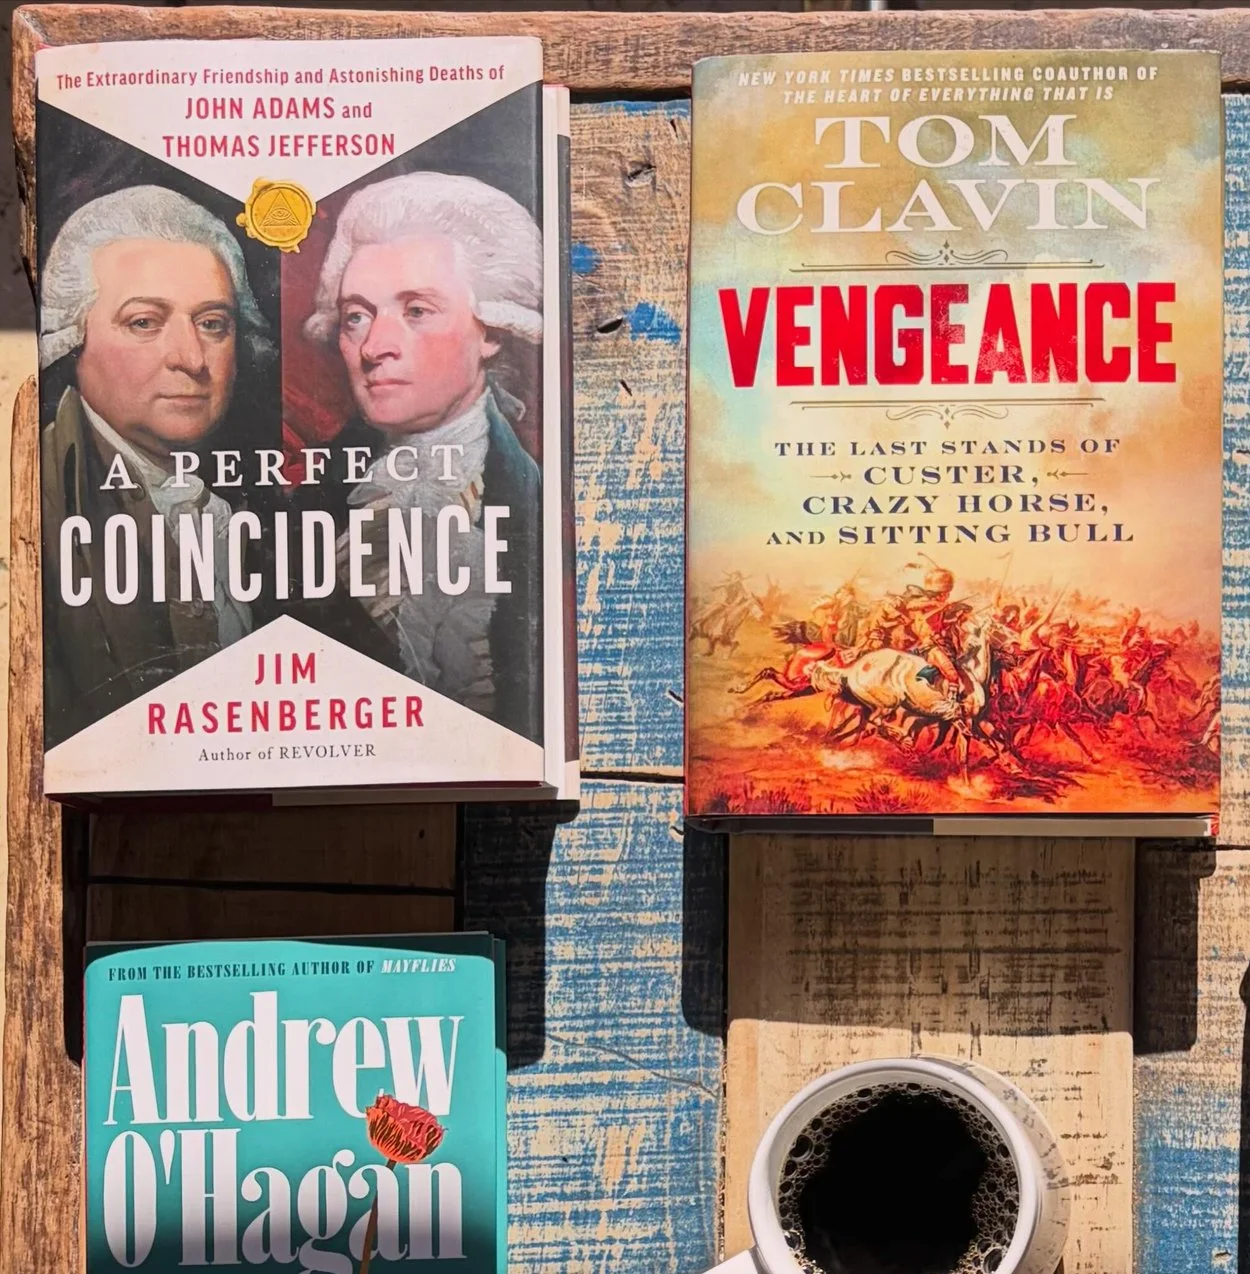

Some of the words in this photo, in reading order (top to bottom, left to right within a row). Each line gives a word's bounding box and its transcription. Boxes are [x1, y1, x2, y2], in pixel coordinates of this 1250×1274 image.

[56, 74, 82, 90] The
[86, 69, 198, 88] Extraordinary
[203, 67, 290, 86] Friendship
[294, 68, 324, 84] and
[328, 66, 425, 85] Astonishing
[430, 65, 484, 82] Deaths
[488, 64, 505, 80] of
[739, 71, 776, 88] NEW
[784, 69, 831, 85] YORK
[840, 68, 895, 83] TIMES
[902, 66, 1025, 82] BESTSELLING
[1032, 66, 1130, 82] COAUTHOR
[1136, 66, 1159, 81] OF
[185, 97, 244, 120] JOHN
[252, 97, 336, 120] ADAMS
[341, 101, 373, 119] and
[162, 134, 260, 158] THOMAS
[268, 133, 396, 157] JEFFERSON
[815, 114, 1078, 169] TOM
[736, 177, 1162, 235] CLAVIN
[718, 282, 1177, 388] VENGEANCE
[775, 441, 837, 458] THE
[850, 440, 929, 457] LAST
[941, 439, 1067, 456] STANDS
[1080, 438, 1122, 454] OF
[100, 453, 139, 491] A
[172, 444, 467, 488] PERFECT
[863, 465, 1039, 489] CUSTER,
[802, 495, 940, 516] CRAZY
[957, 492, 1111, 517] HORSE,
[766, 530, 826, 546] AND
[838, 524, 1011, 545] SITTING
[1028, 522, 1135, 543] BULL
[60, 505, 513, 607] COINCIDENCE
[255, 652, 317, 685] JIM
[148, 695, 425, 735] RASENBERGER
[199, 747, 251, 763] Author
[257, 746, 274, 760] of
[279, 743, 377, 760] REVOLVER
[108, 966, 147, 981] FROM
[152, 965, 182, 980] THE
[187, 963, 286, 979] BESTSELLING
[291, 961, 351, 976] AUTHOR
[356, 960, 375, 975] OF
[380, 957, 457, 975] MAYFLIES
[103, 990, 464, 1126] Andrew
